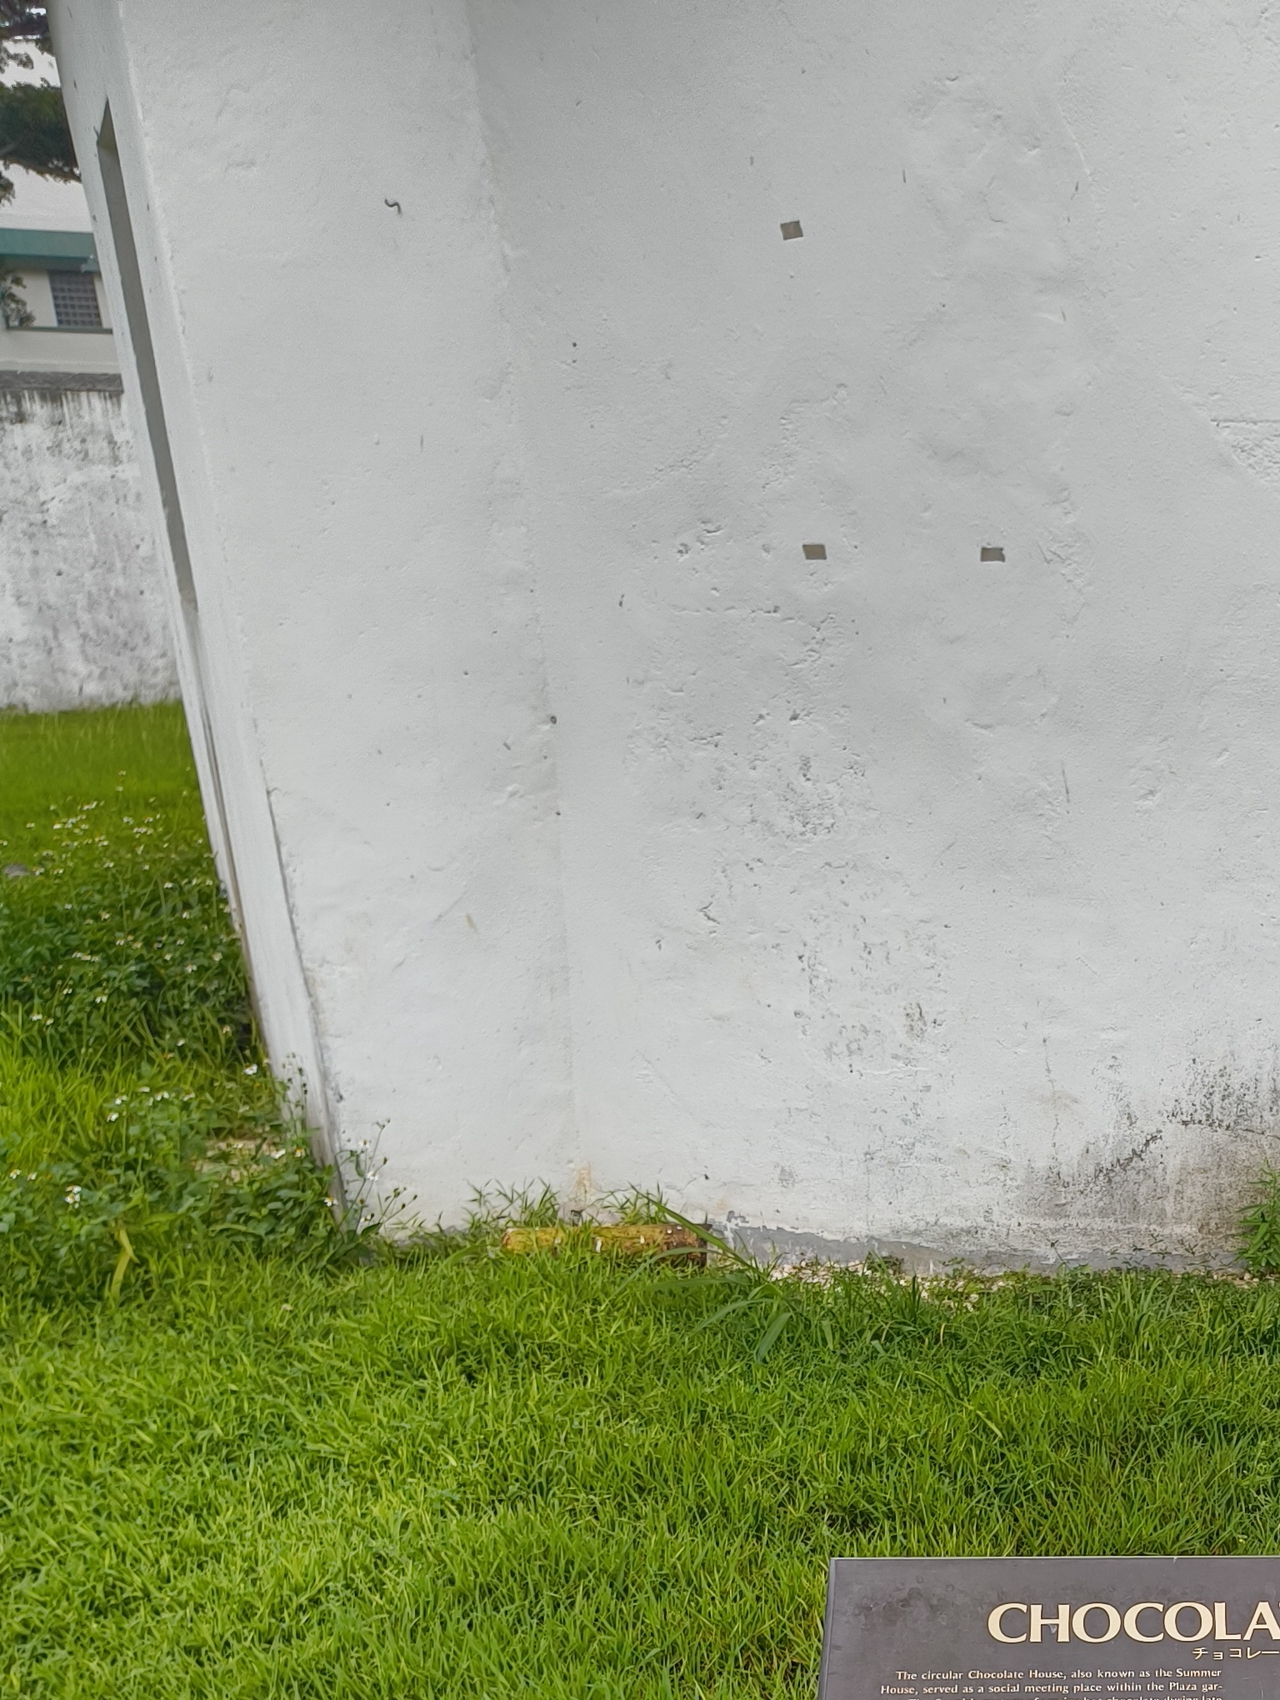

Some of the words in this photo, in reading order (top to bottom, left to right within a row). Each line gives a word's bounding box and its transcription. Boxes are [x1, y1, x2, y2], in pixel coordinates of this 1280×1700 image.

[895, 1671, 918, 1681] The
[921, 1669, 964, 1680] circular
[968, 1669, 1024, 1680] Chocolate
[1029, 1669, 1067, 1681] House,
[1070, 1669, 1093, 1679] also
[1097, 1668, 1135, 1678] known
[1139, 1670, 1151, 1678] as
[1155, 1667, 1173, 1678] the
[1175, 1667, 1222, 1678] Summer
[880, 1685, 919, 1696] House,
[922, 1684, 959, 1694] served
[962, 1685, 974, 1693] as
[988, 1683, 1020, 1693] social
[1024, 1682, 1069, 1695] meeting
[1073, 1682, 1102, 1694] place
[1106, 1681, 1142, 1692] within
[1146, 1681, 1165, 1692] the
[1169, 1681, 1197, 1691] Plaza
[1201, 1683, 1223, 1693] gar-
